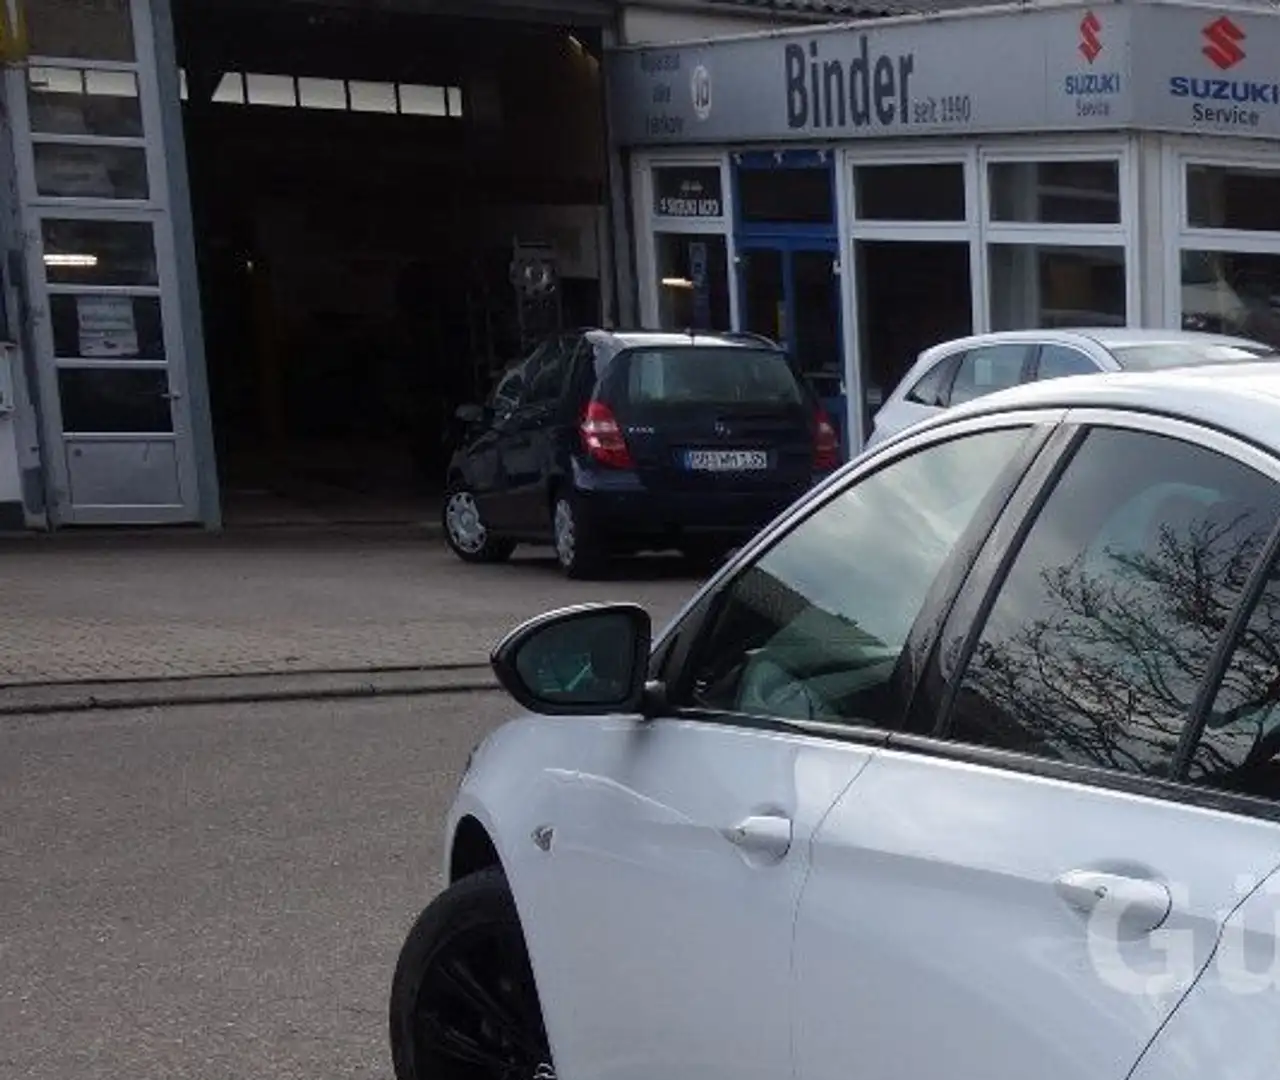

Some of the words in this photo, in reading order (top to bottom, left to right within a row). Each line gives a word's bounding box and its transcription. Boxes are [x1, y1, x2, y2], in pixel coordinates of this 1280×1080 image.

[785, 35, 914, 128] Binder
[1065, 74, 1120, 95] SUZUKI
[1169, 76, 1279, 104] SUZUKI
[1192, 103, 1260, 125] Service
